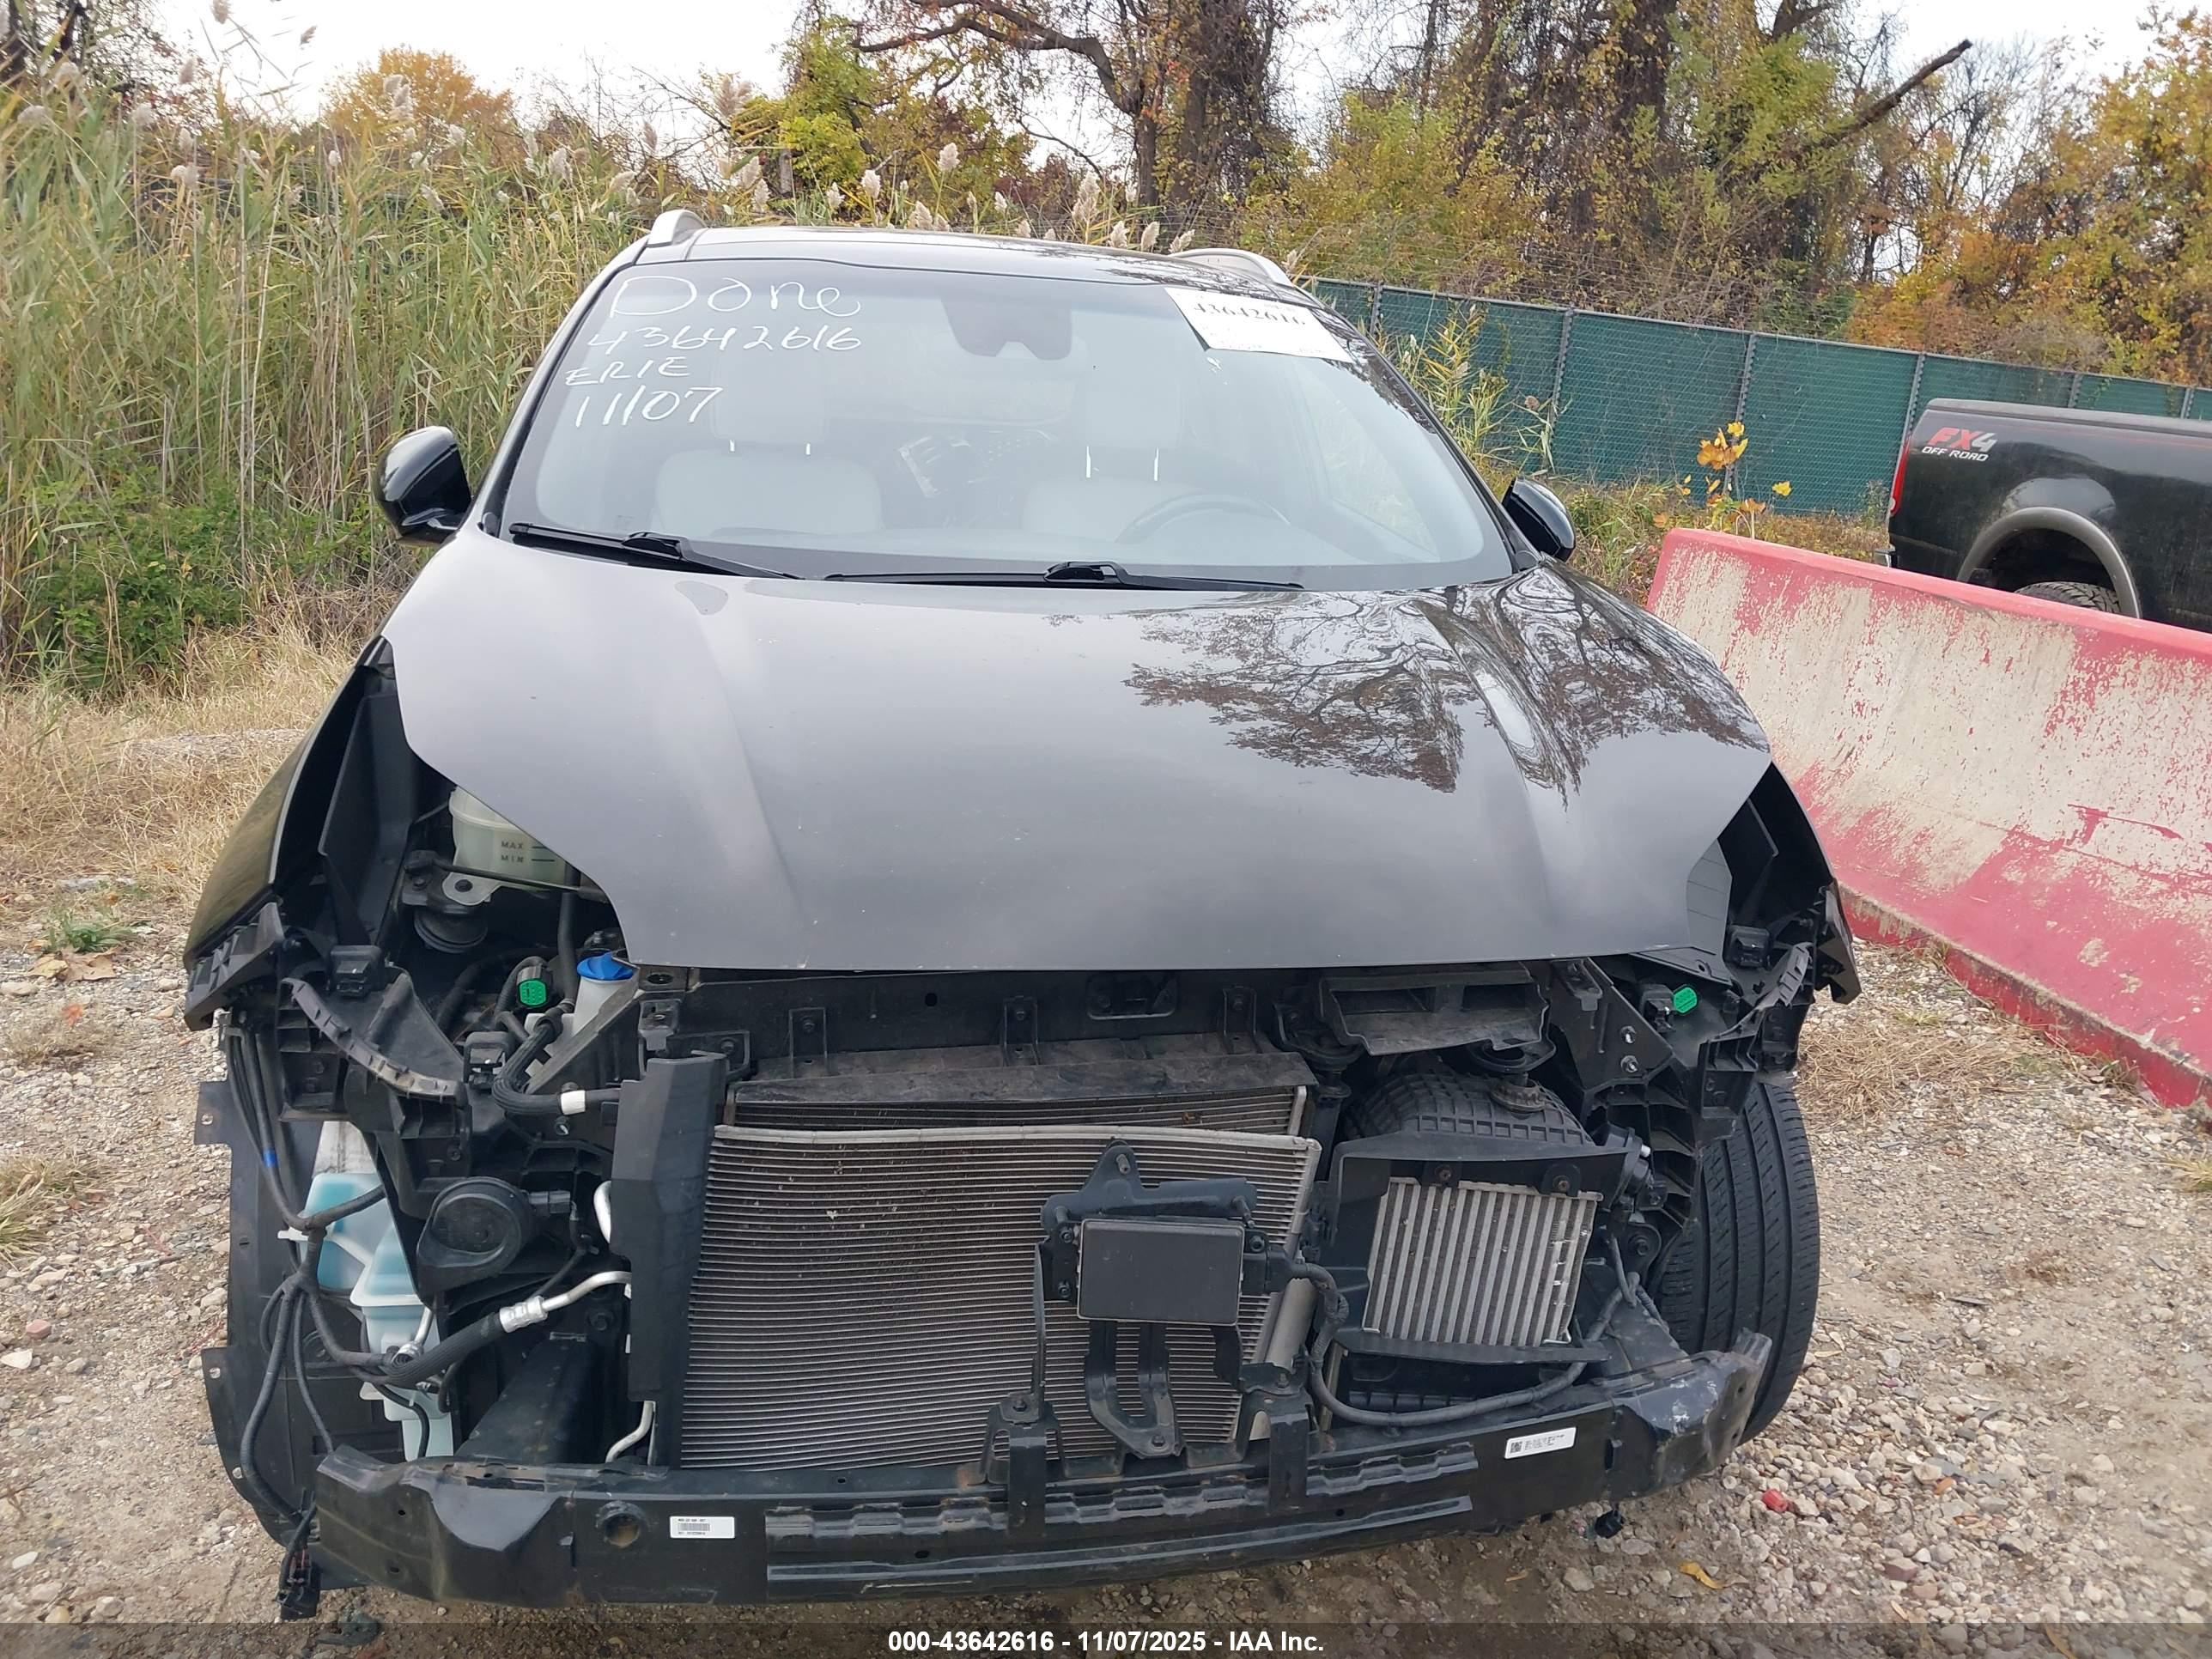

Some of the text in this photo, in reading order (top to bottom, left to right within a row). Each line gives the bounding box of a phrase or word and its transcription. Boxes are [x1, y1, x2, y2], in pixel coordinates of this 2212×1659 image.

[609, 276, 860, 318] Done
[588, 325, 862, 355] 43642616
[564, 356, 690, 386] ERIE
[575, 385, 722, 428] 11/07
[1929, 427, 1997, 452] FX4
[1922, 446, 1990, 462] OFF ROAD
[501, 841, 524, 850] MAX
[501, 854, 525, 863] MIN
